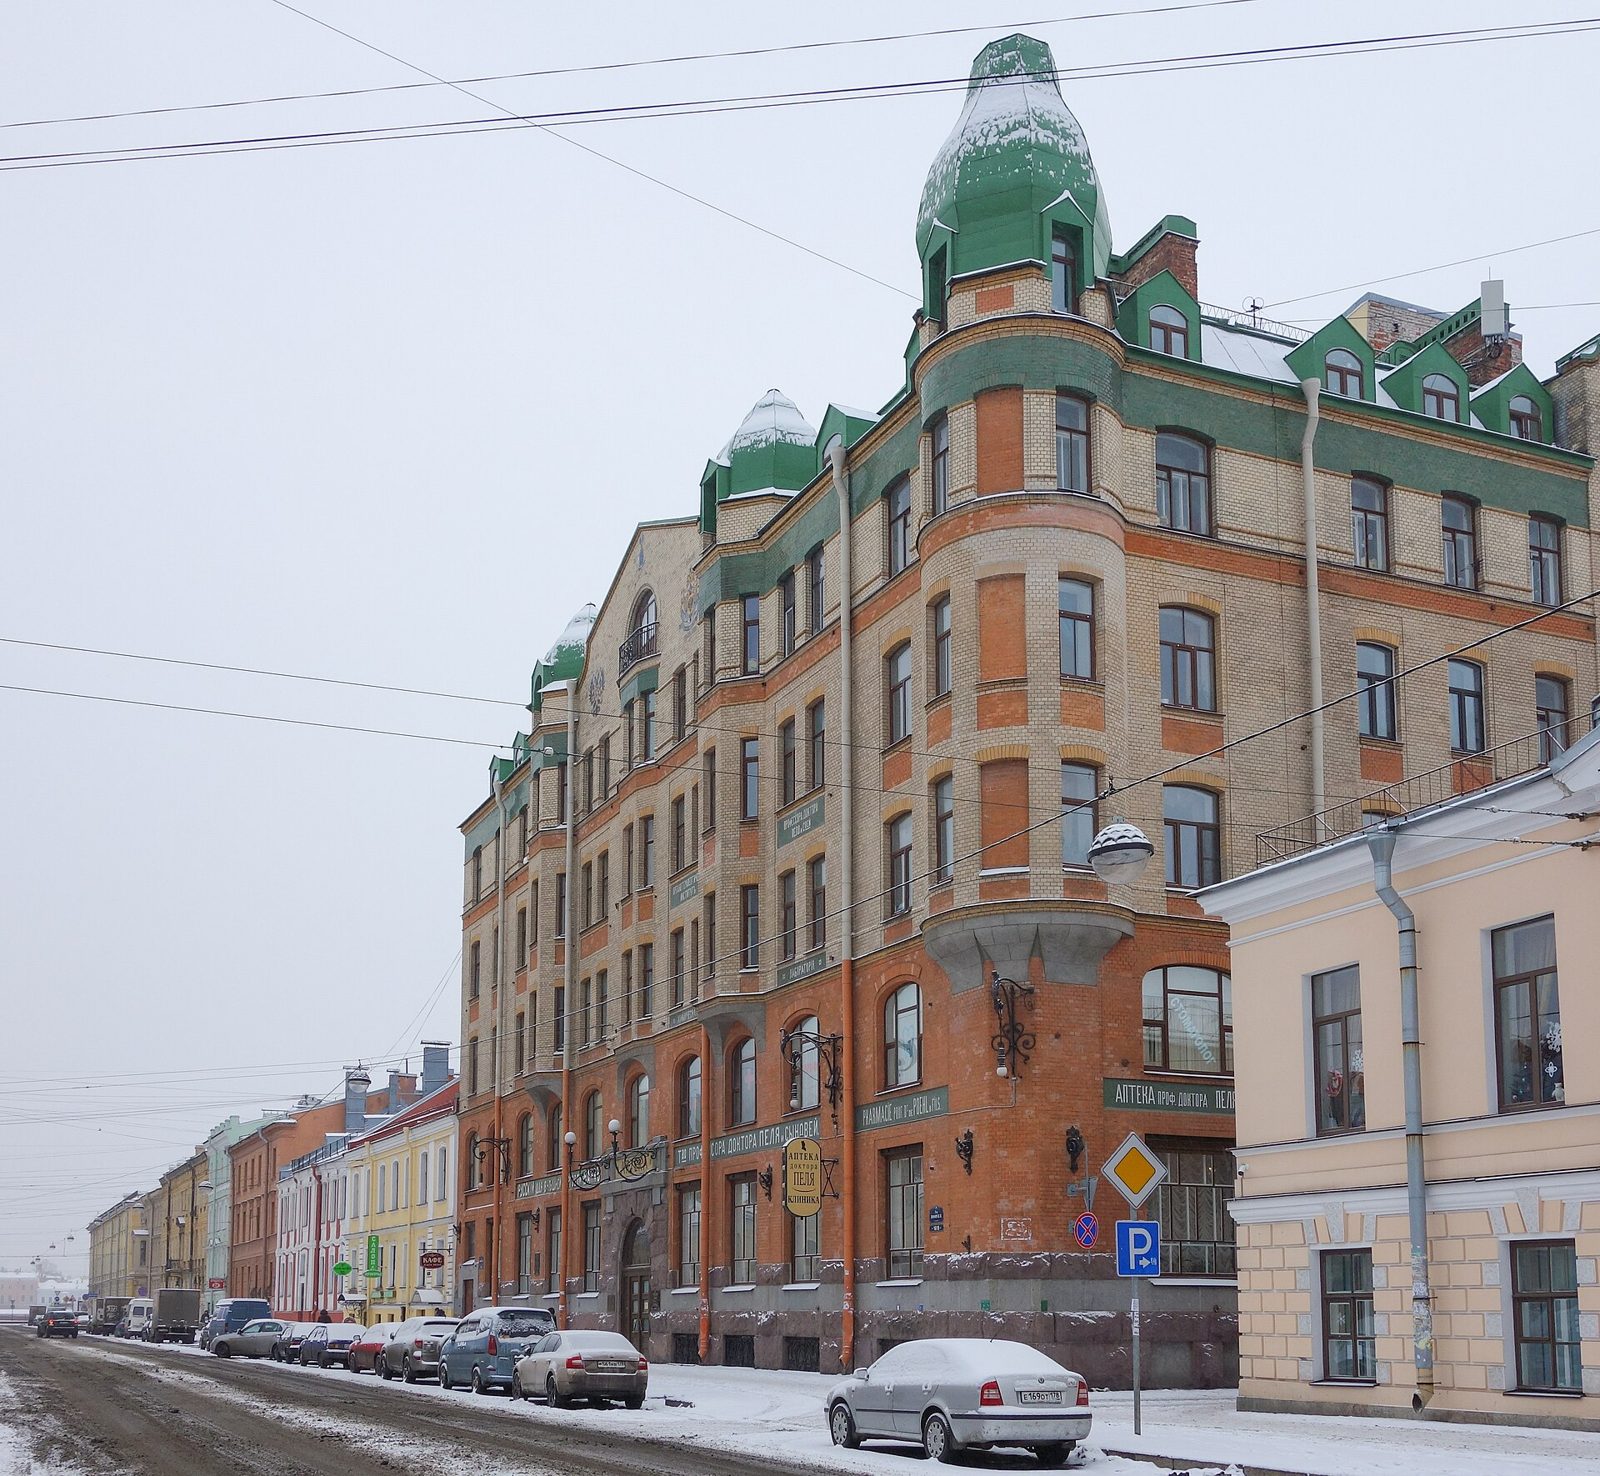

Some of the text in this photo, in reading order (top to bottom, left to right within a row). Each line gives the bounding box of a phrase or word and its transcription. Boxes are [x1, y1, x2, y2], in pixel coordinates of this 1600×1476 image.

[1115, 1083, 1156, 1105] АПТЕКА
[1157, 1090, 1177, 1106] ПРОФ.
[1178, 1092, 1208, 1108] ДОКТОРА
[727, 1134, 757, 1154] ДОКТОРА
[759, 1126, 780, 1147] ПЕЛЯ
[788, 1152, 819, 1161] АПТЕКА
[790, 1163, 818, 1171] доктора
[793, 1171, 815, 1187] ПЕЛЯ
[788, 1195, 820, 1204] КЛИНИКА
[1128, 1227, 1152, 1270] P
